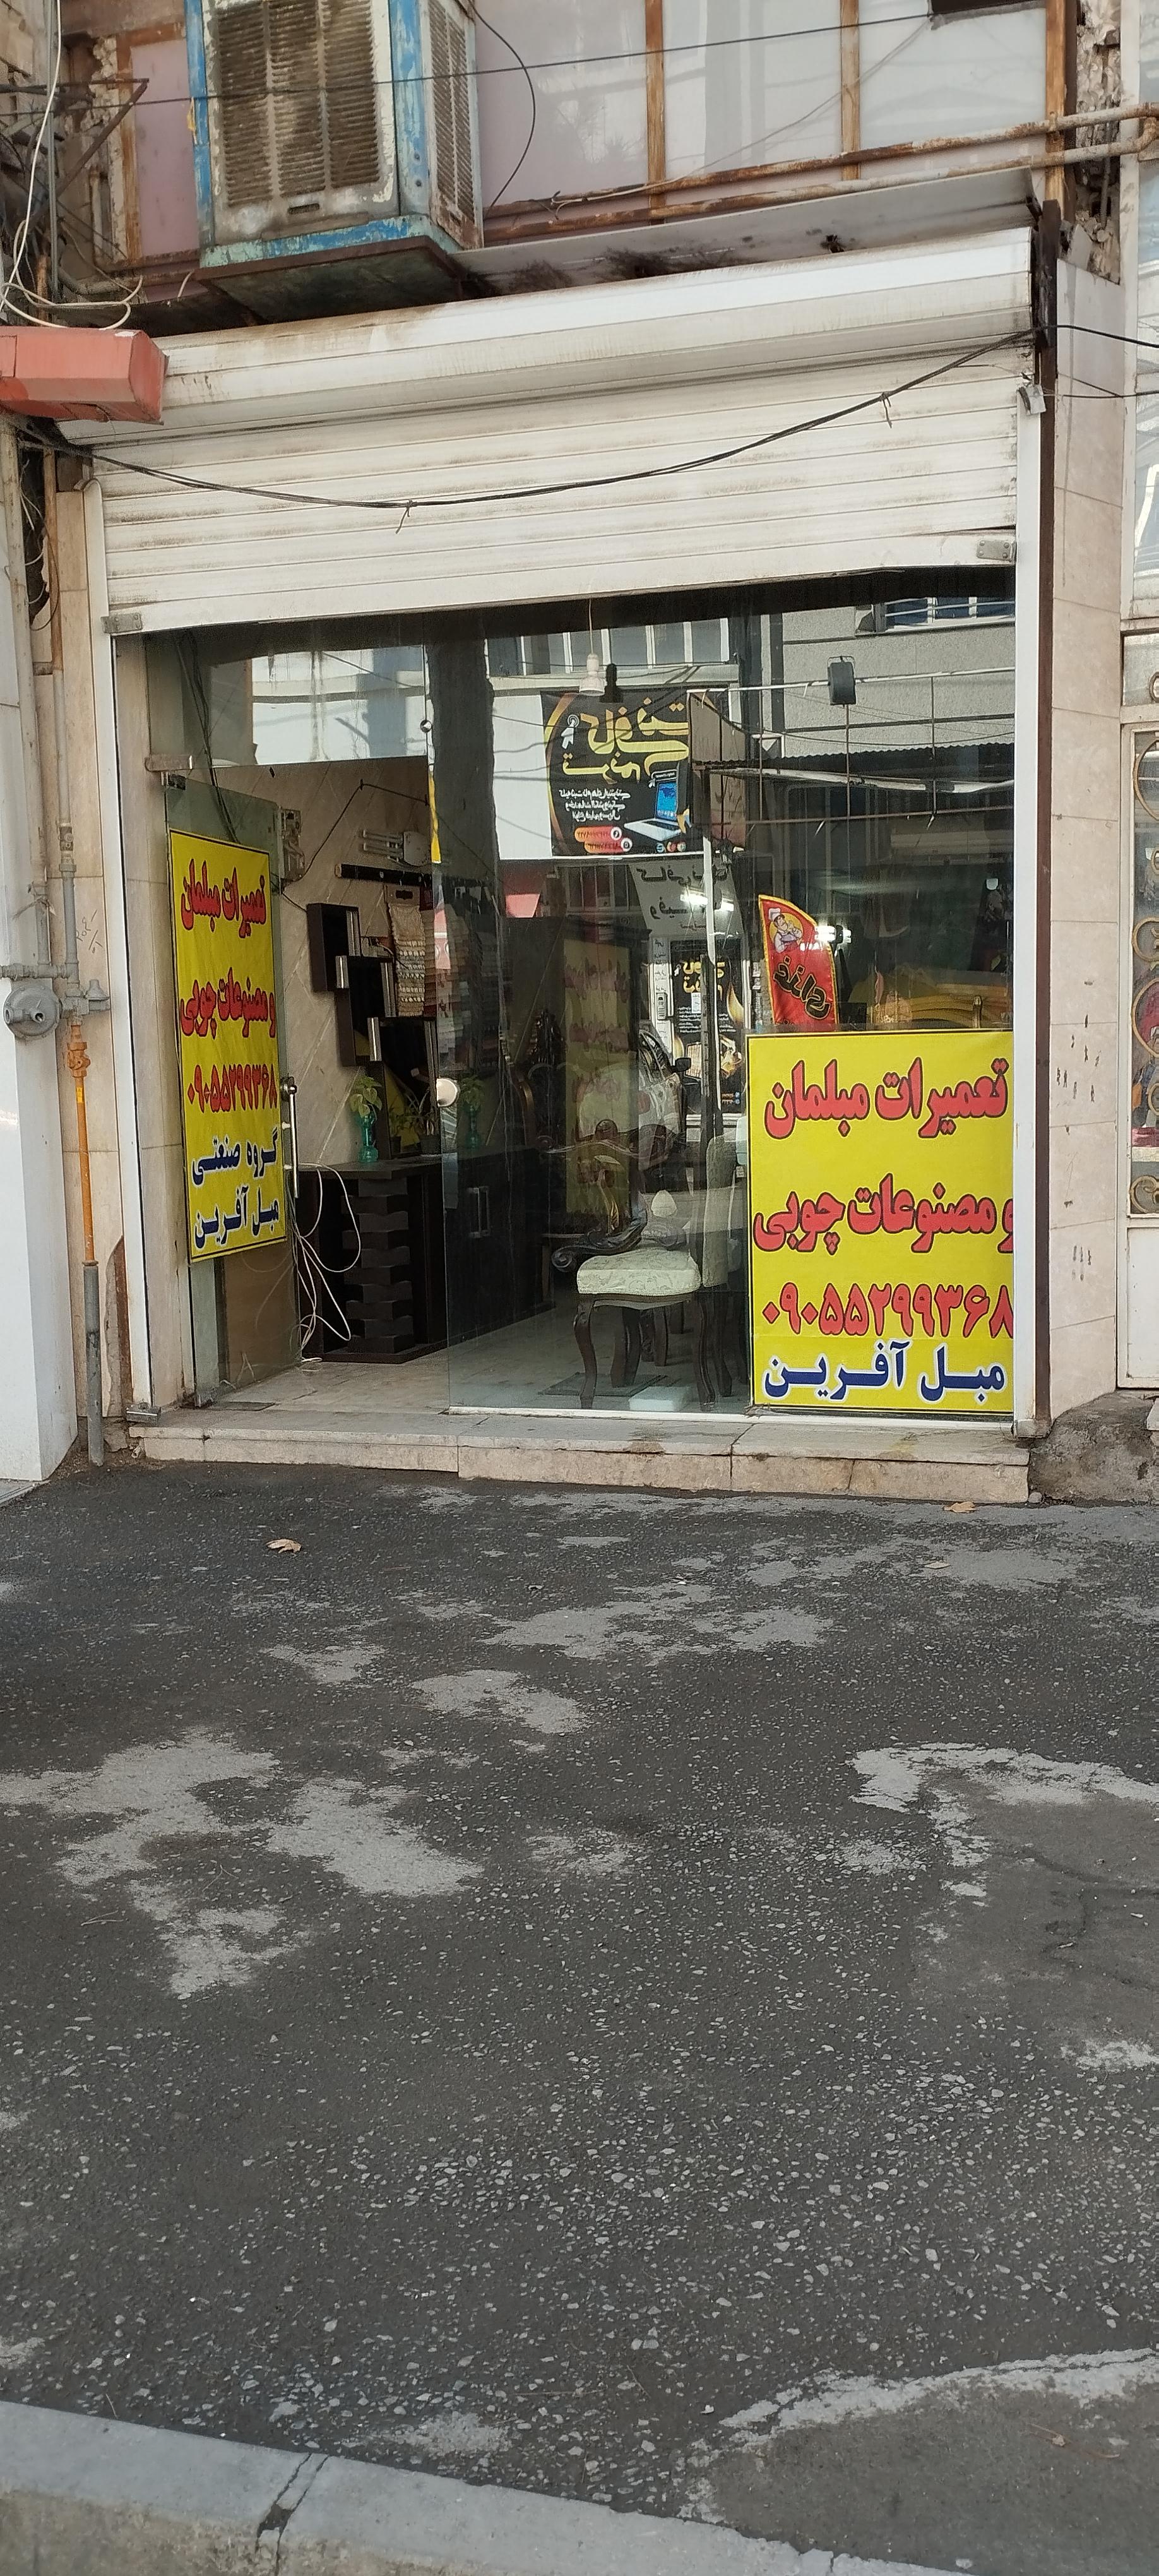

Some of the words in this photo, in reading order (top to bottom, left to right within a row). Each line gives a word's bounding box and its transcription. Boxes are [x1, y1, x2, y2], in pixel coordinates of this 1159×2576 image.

[181, 858, 222, 933] مبلمان
[222, 866, 268, 938] تعمیرات
[181, 979, 218, 1040] چوبی
[217, 966, 268, 1037] مصنوعات
[268, 991, 276, 1039] و
[187, 1062, 278, 1114] ۰۹۰۵۵۲۹۹۳۶۸
[764, 1058, 870, 1140] مبلمان
[875, 1057, 1008, 1138] تعمیرات
[191, 1133, 241, 1187] صنعتی
[246, 1126, 279, 1179] گروه
[194, 1185, 249, 1250] آفرین
[249, 1185, 279, 1239] مبل
[754, 1190, 845, 1255] چوبی
[847, 1173, 996, 1254] مصنوعات
[761, 1282, 1014, 1338] ۰۹۰۵۵۲۹۹۳۶۸
[764, 1340, 909, 1400] آفرین
[920, 1347, 1006, 1402] مبل
